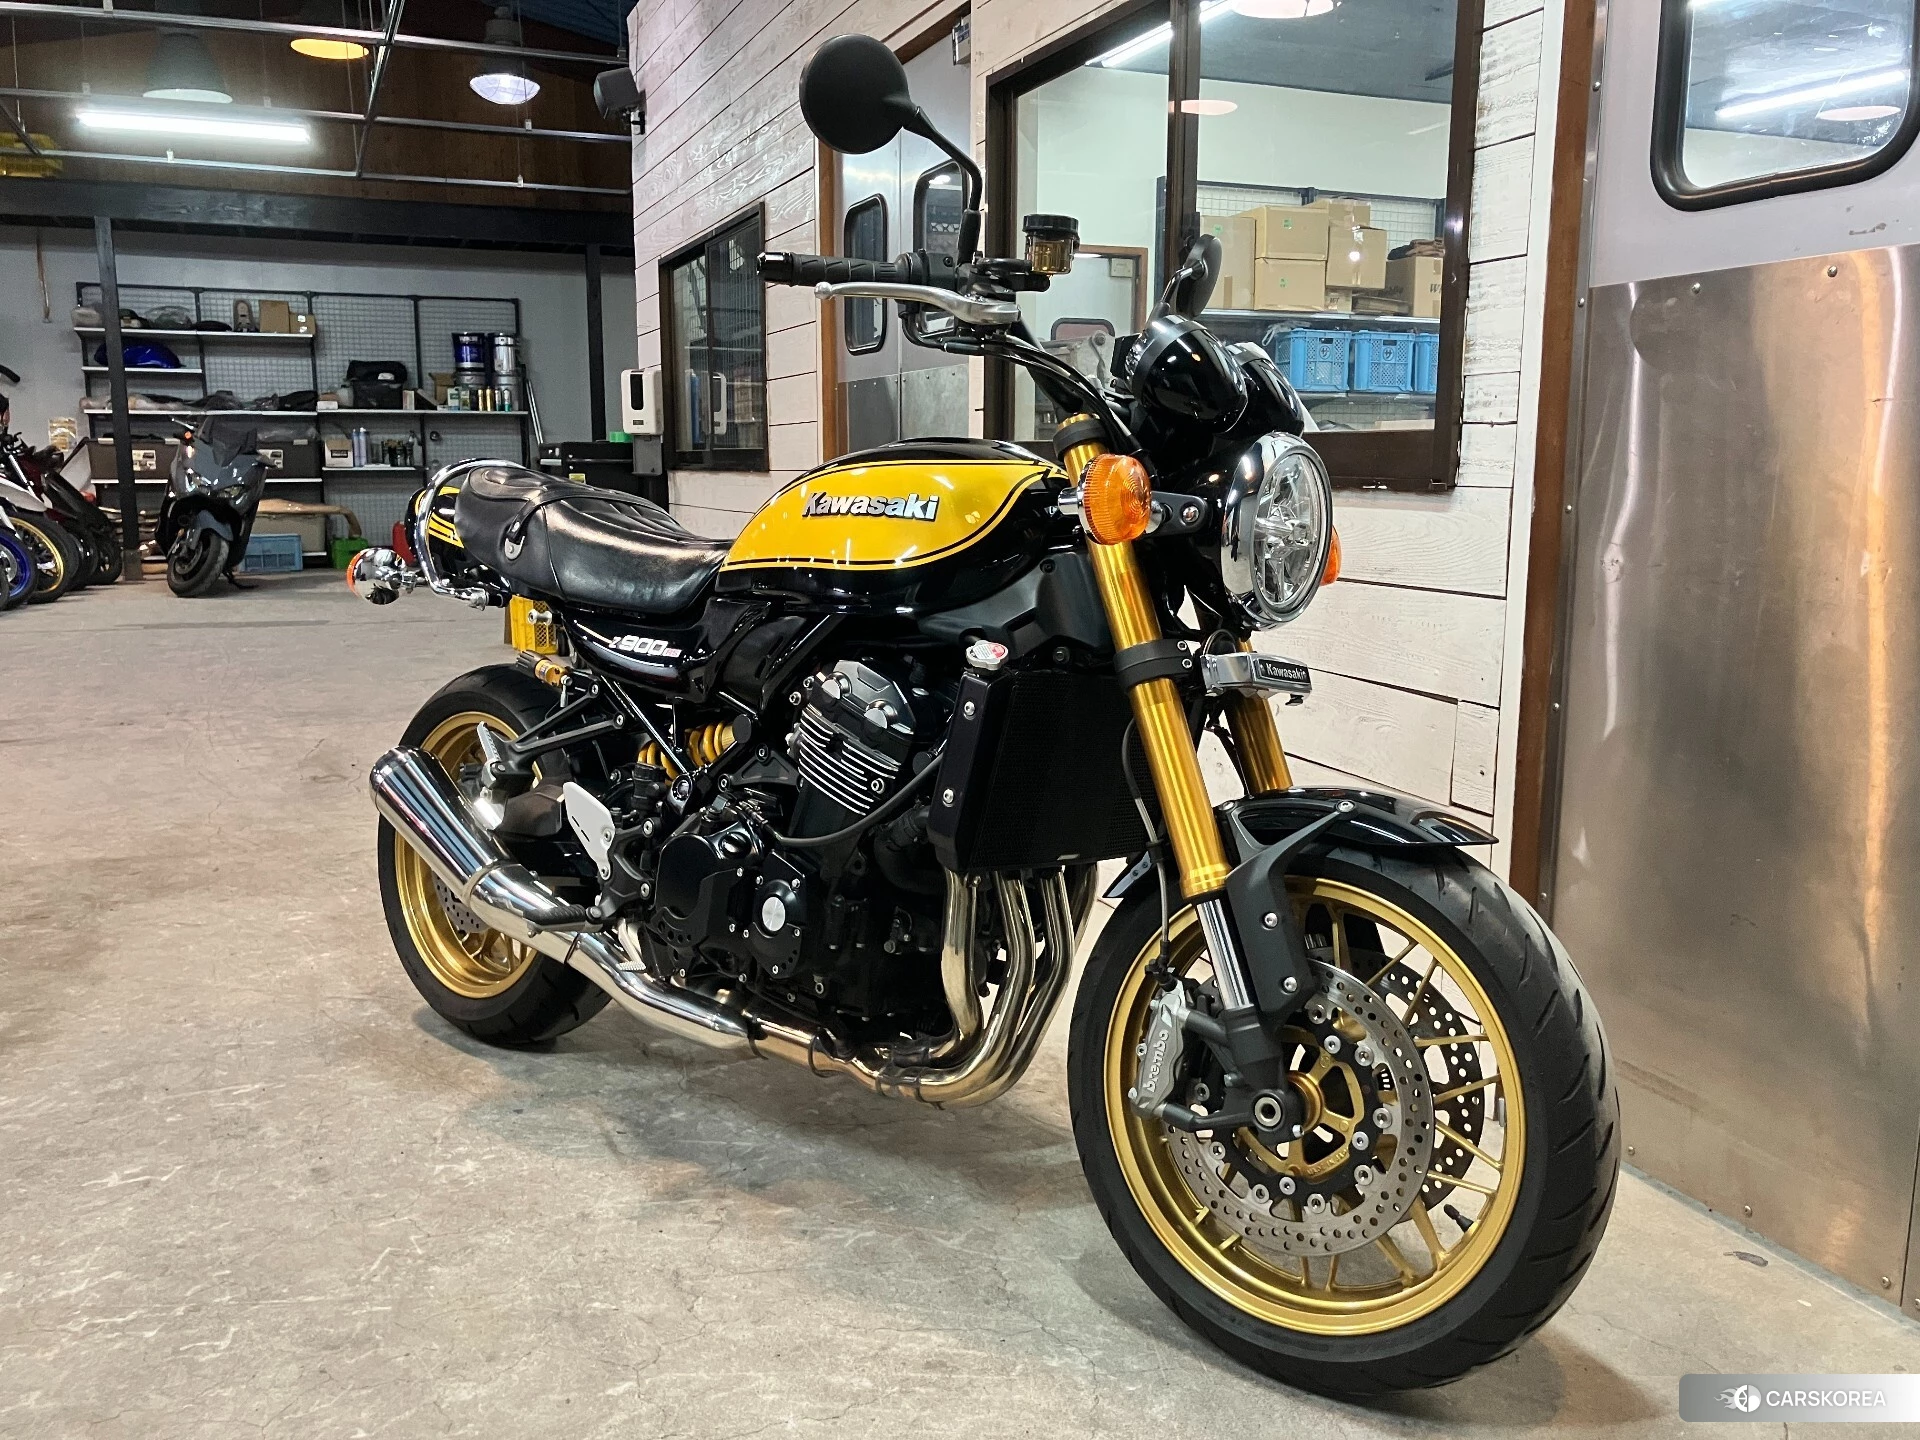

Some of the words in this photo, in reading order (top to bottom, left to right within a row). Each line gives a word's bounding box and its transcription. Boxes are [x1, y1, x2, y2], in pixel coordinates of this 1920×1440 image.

[802, 492, 939, 521] Kawasaki
[1266, 663, 1303, 680] Kawasaki
[1143, 1029, 1169, 1093] brembo
